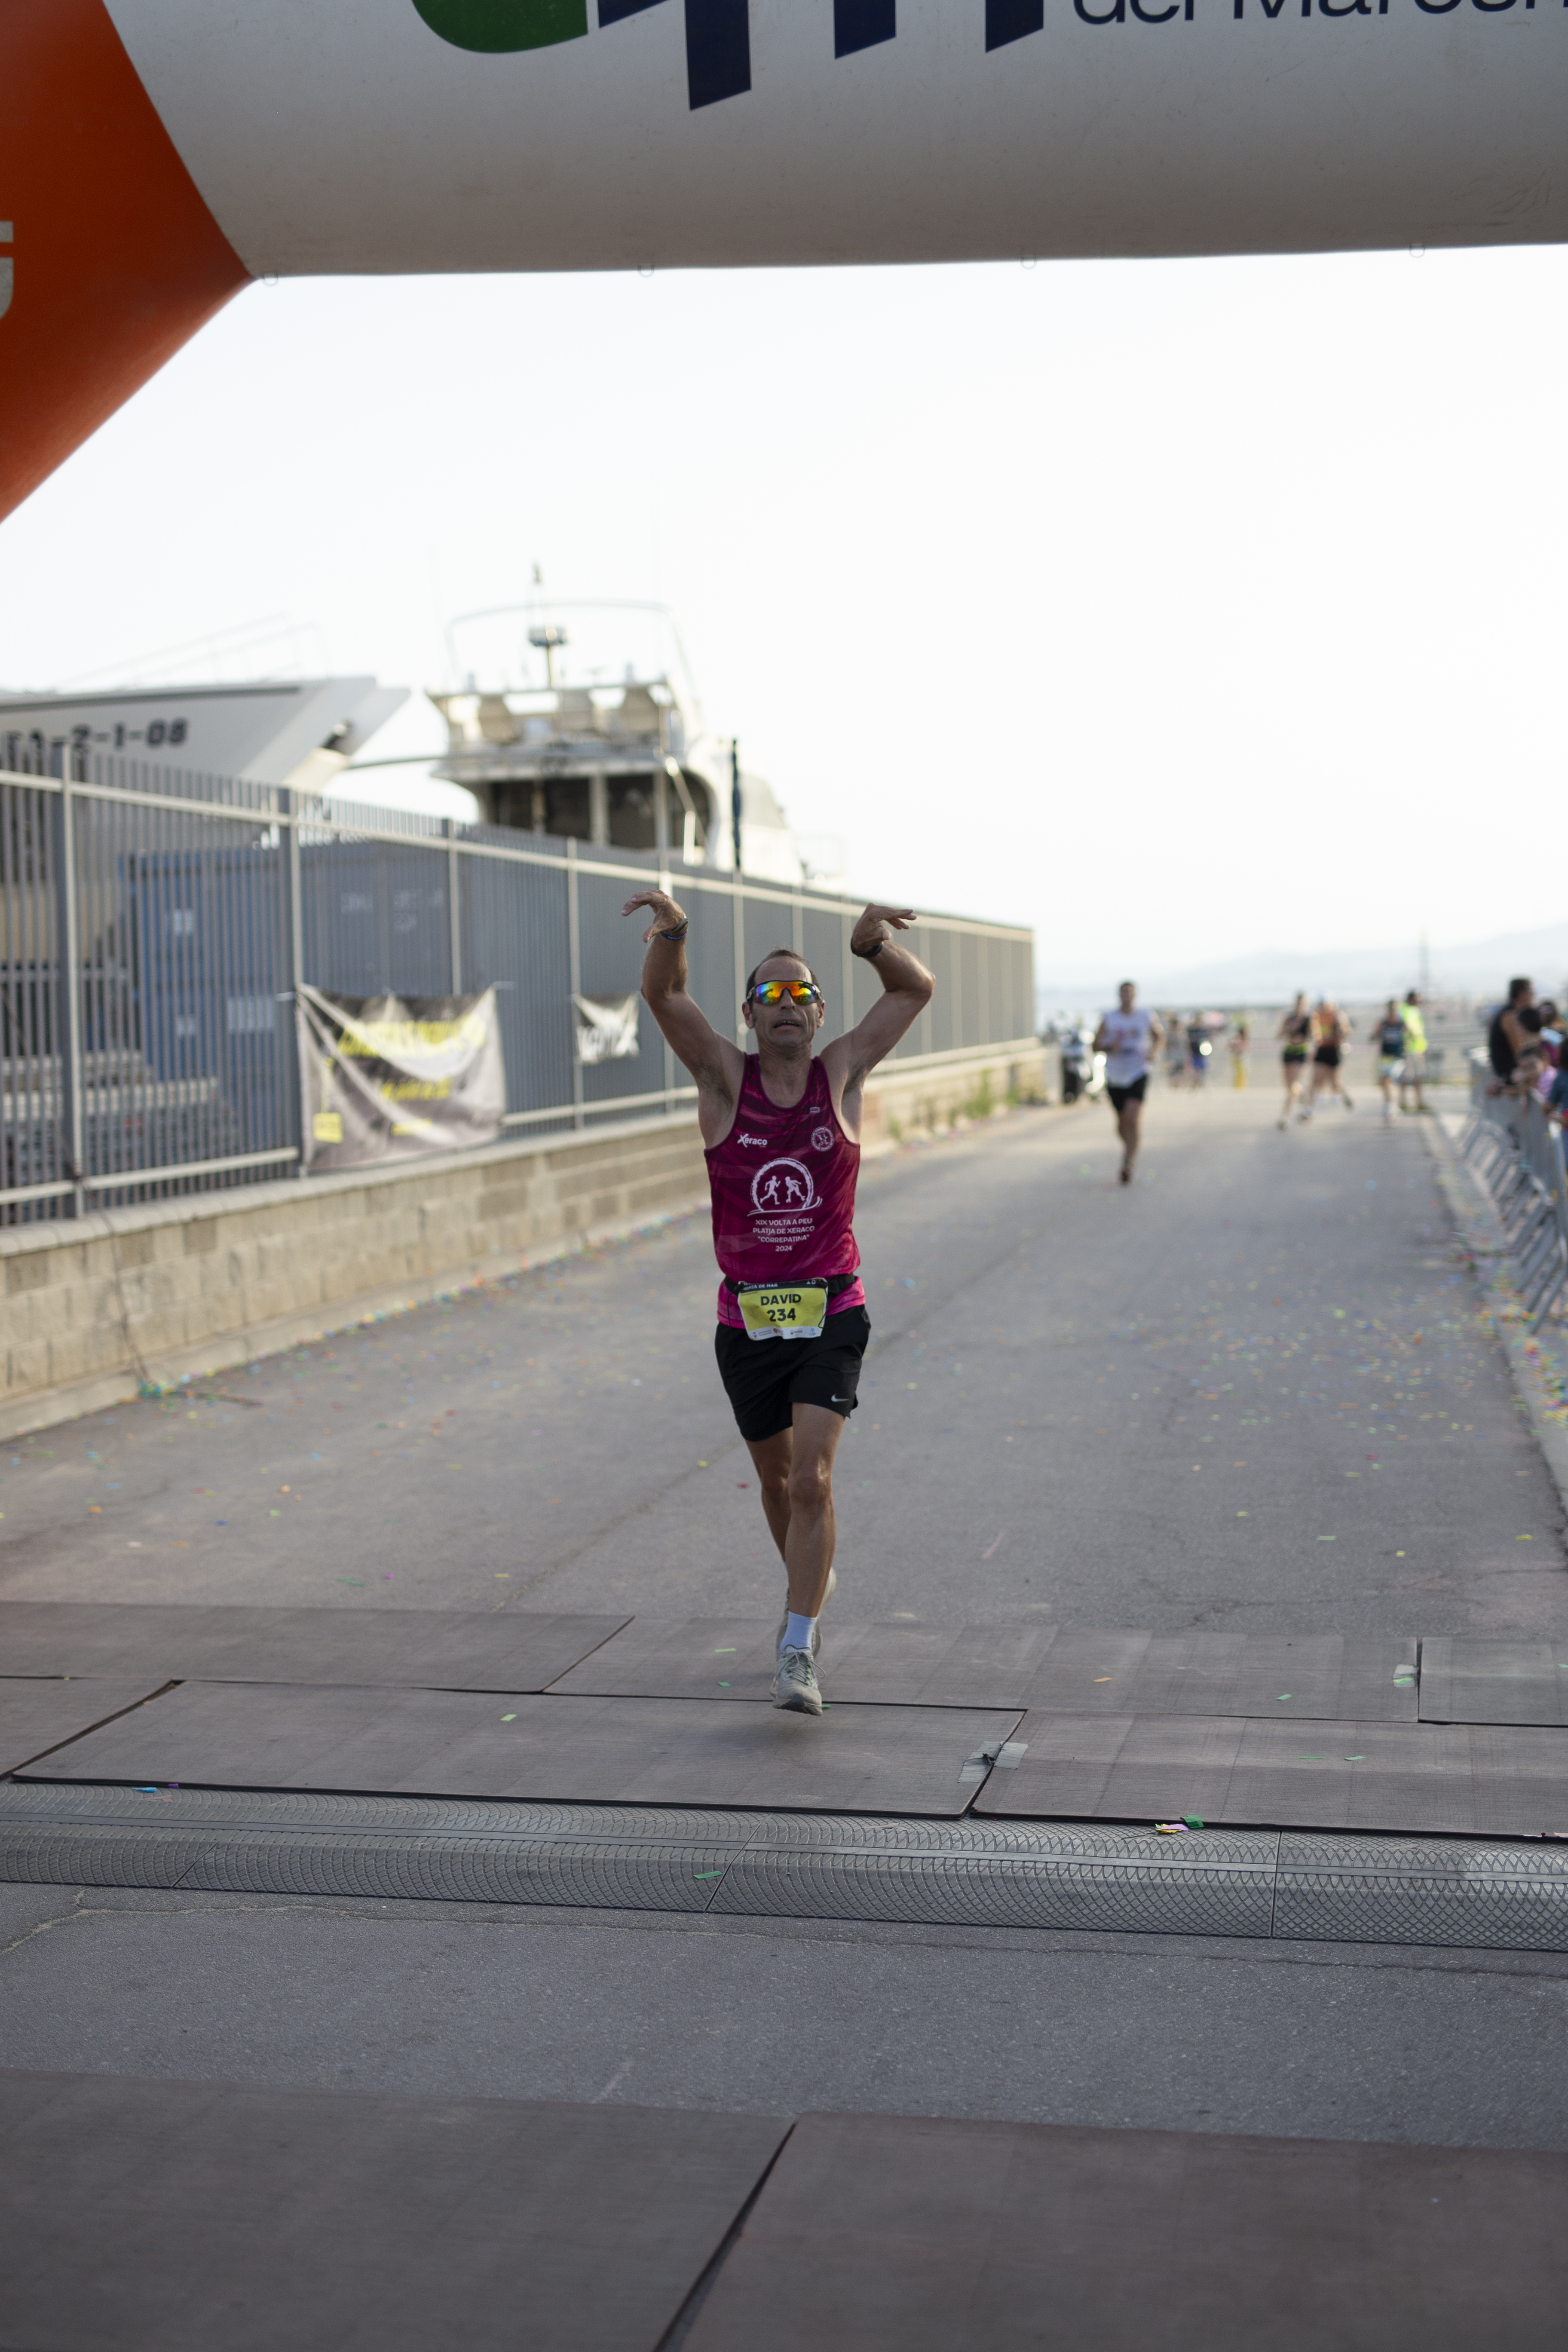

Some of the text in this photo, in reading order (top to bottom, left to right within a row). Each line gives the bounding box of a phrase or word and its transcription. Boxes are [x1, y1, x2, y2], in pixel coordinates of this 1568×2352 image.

[737, 1133, 767, 1148] Xeraco
[787, 1225, 815, 1234] XERACO
[760, 1293, 802, 1306] DAVID
[767, 1308, 796, 1322] 234
